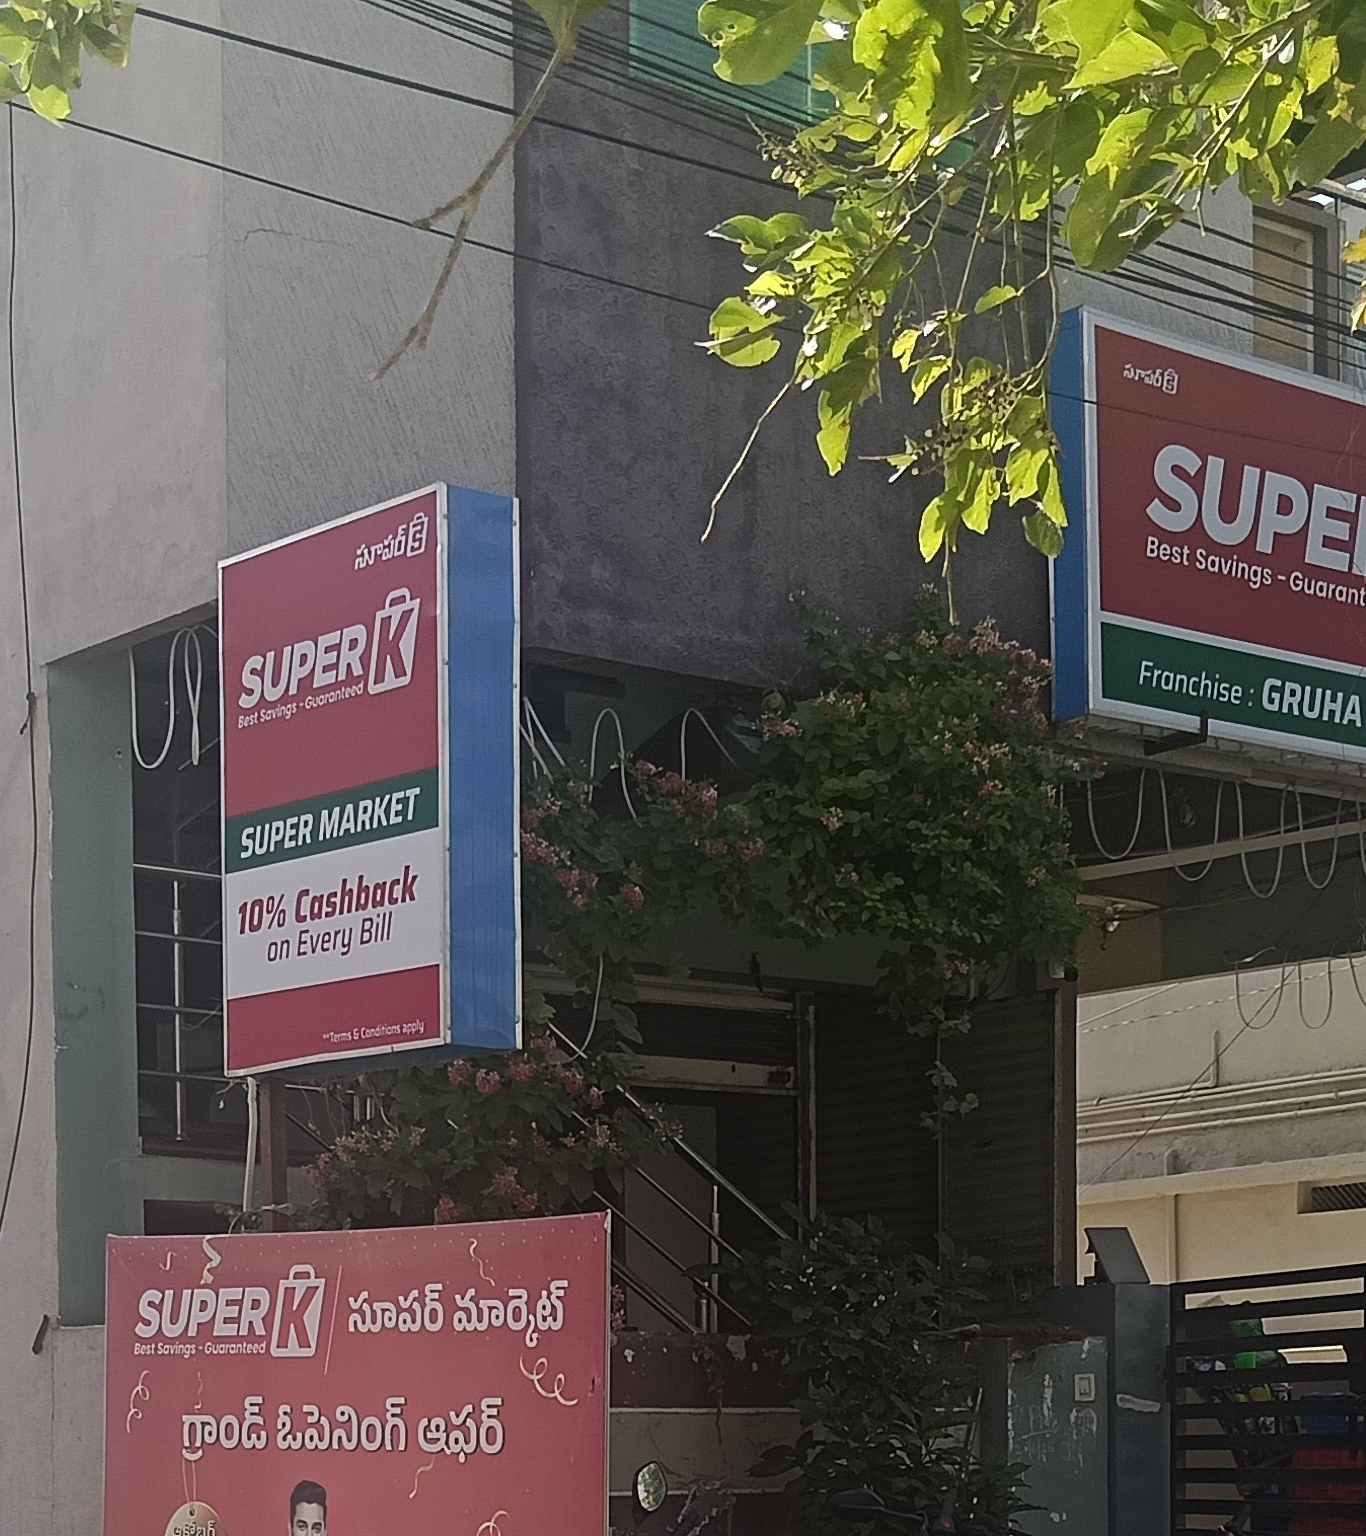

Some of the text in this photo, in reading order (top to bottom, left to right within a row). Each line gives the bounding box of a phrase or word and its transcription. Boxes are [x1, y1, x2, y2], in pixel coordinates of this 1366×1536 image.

[1146, 536, 1189, 566] Best
[1196, 545, 1271, 589] Savings
[238, 711, 258, 729] Best
[260, 703, 297, 722] Savings
[304, 680, 364, 710] Guaranteed
[1261, 677, 1362, 727] GRUHA
[240, 787, 421, 859] SUPER MARKET
[238, 864, 419, 935] 10% Cashback
[267, 911, 393, 962] on Every Bill
[353, 1028, 360, 1040] &
[361, 1022, 401, 1038] Conditions
[402, 1019, 424, 1034] apply
[348, 1279, 569, 1348] సూపర్ మార్కెట్
[134, 1342, 156, 1355] Best
[157, 1341, 196, 1358] Savings
[204, 1341, 266, 1354] Guaranteed
[182, 1396, 503, 1463] గ్రాండ్ ఓపెనింగ్ ఆఫర్
